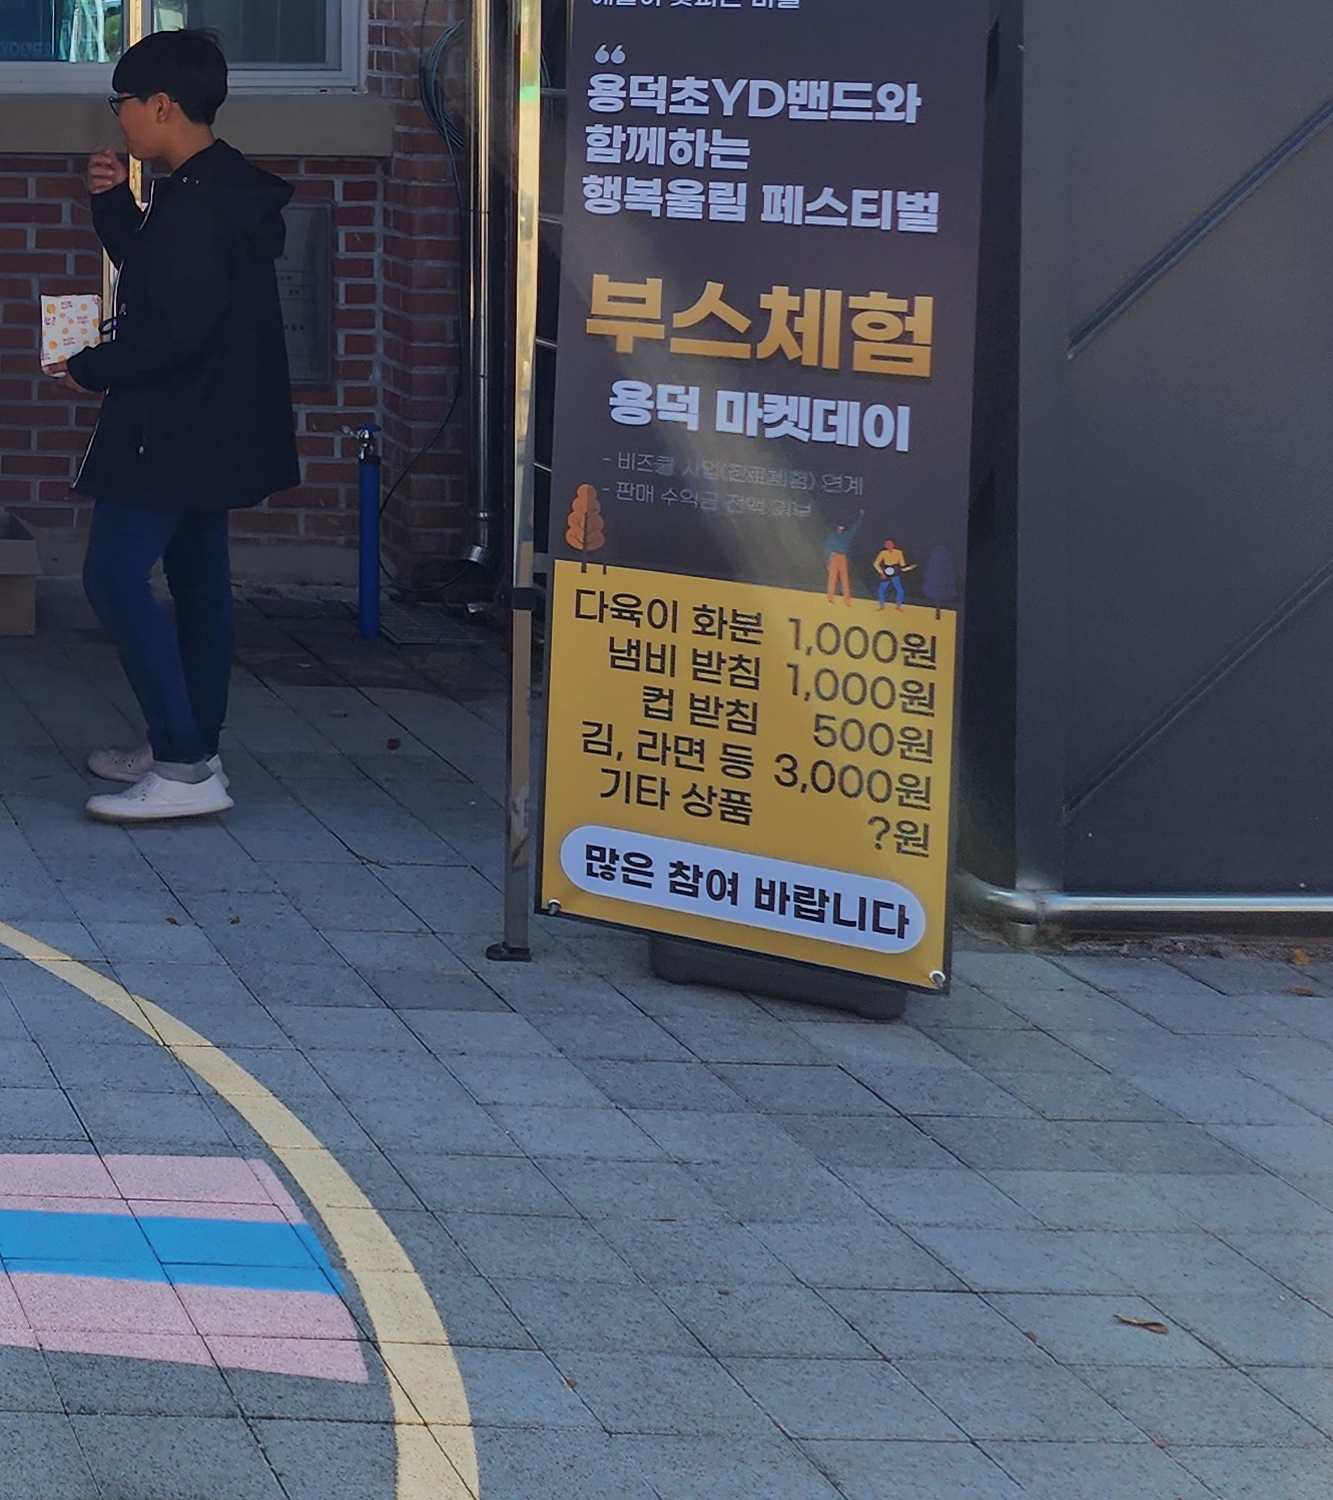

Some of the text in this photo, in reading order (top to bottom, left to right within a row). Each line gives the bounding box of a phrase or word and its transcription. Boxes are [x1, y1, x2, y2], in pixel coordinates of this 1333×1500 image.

[587, 73, 921, 124] 용덕초YD밴드와
[584, 124, 751, 170] 함께하는
[581, 173, 940, 234] 행복울림 페스티벌
[585, 273, 934, 378] 부스체험
[608, 380, 910, 452] 용덕 마켓데이
[615, 481, 655, 504] 판매
[574, 588, 938, 671] 다육이 화분 1,000원
[608, 636, 936, 717] 냄비 받침 1,000원
[641, 684, 934, 764] 컵 받침 500원
[581, 719, 932, 811] 김, 라면 등 3,000원
[599, 767, 930, 859] 기타 상품 ?원
[583, 842, 910, 940] 많은 참여 바랍니다
